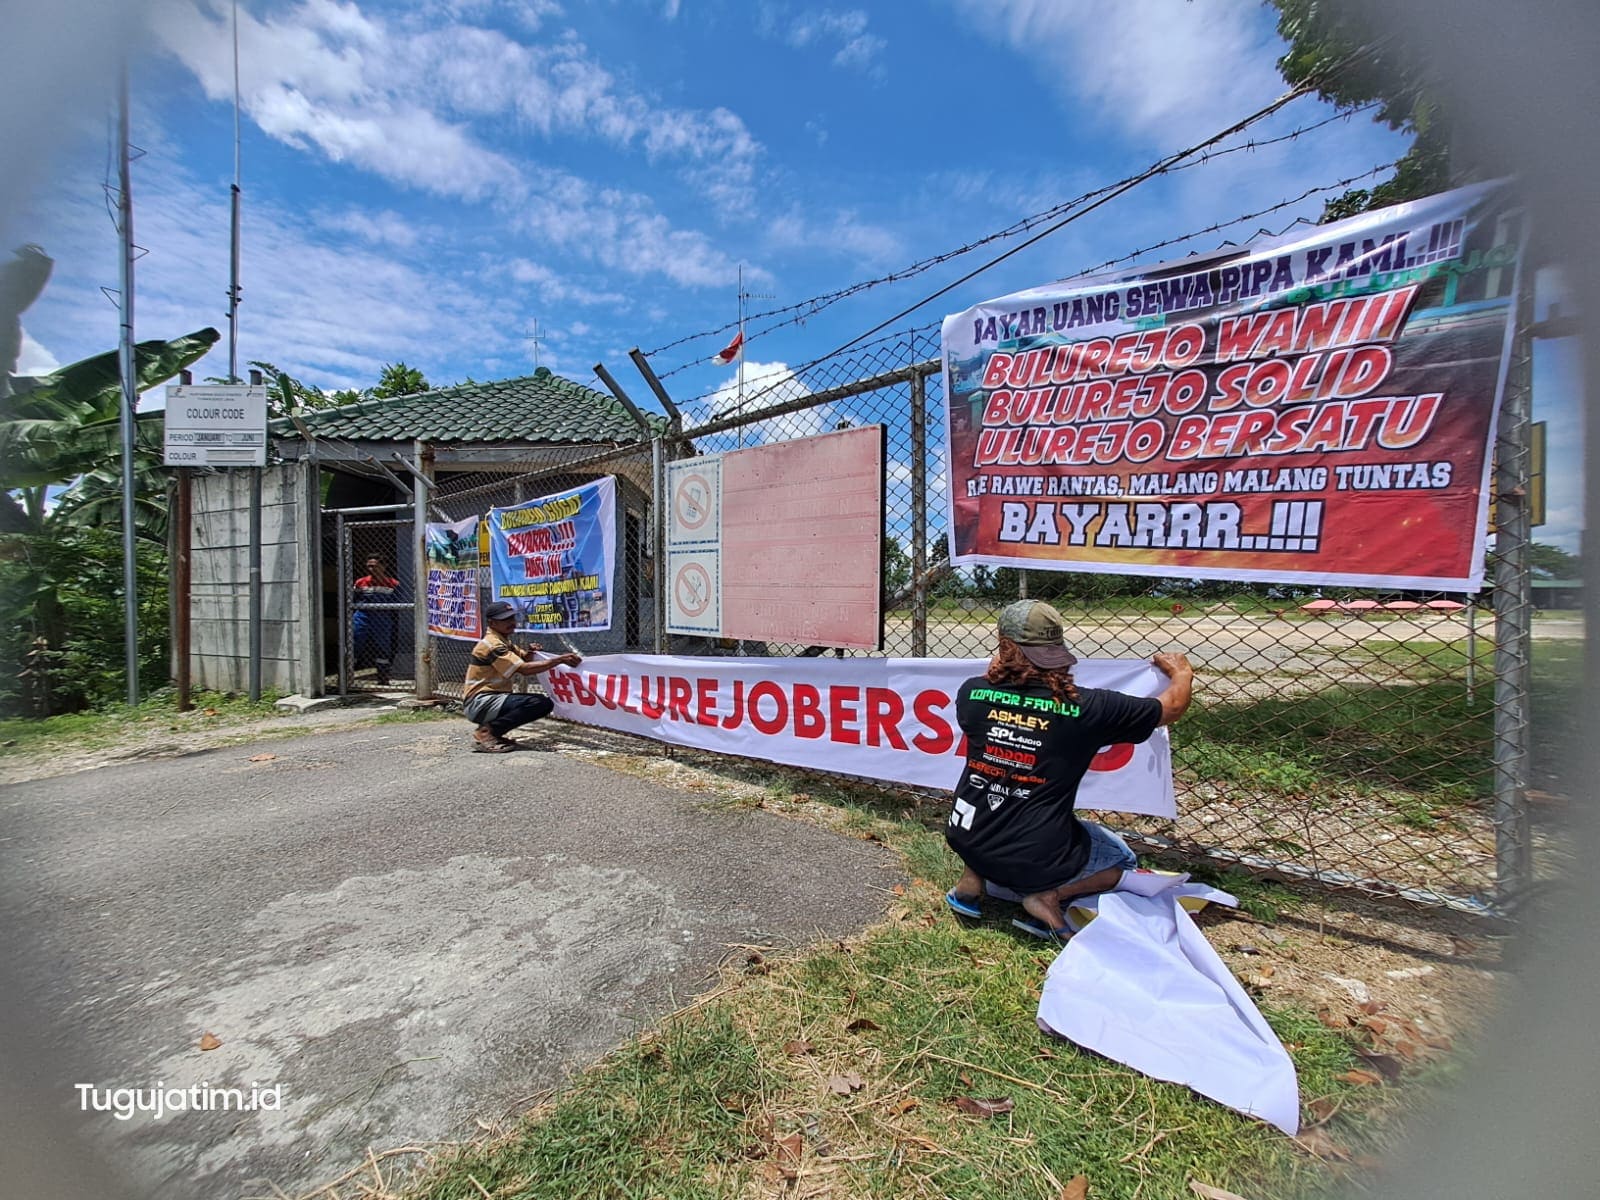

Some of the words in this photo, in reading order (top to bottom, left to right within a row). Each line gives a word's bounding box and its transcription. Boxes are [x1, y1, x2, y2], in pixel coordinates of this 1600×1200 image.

[1053, 290, 1121, 331] UANG
[1126, 273, 1215, 318] SEWA
[1219, 254, 1295, 304] PIPA
[982, 324, 1206, 389] BULUREJO
[981, 369, 1208, 427] BULUREJO
[1208, 344, 1393, 412] SOLID
[186, 408, 220, 419] COLOUR
[222, 408, 245, 420] CODE
[974, 419, 1165, 467] ULUREJO
[1166, 393, 1445, 462] BERSATU
[169, 433, 194, 442] PERIOD
[169, 452, 197, 461] COLOUR
[991, 475, 1044, 496] RAWE
[1047, 473, 1123, 499] RANTAS,
[1129, 471, 1217, 496] MALANG
[1222, 465, 1329, 493] MALANG
[1335, 461, 1453, 490] TUNTAS
[985, 744, 1036, 766] WISDOM
